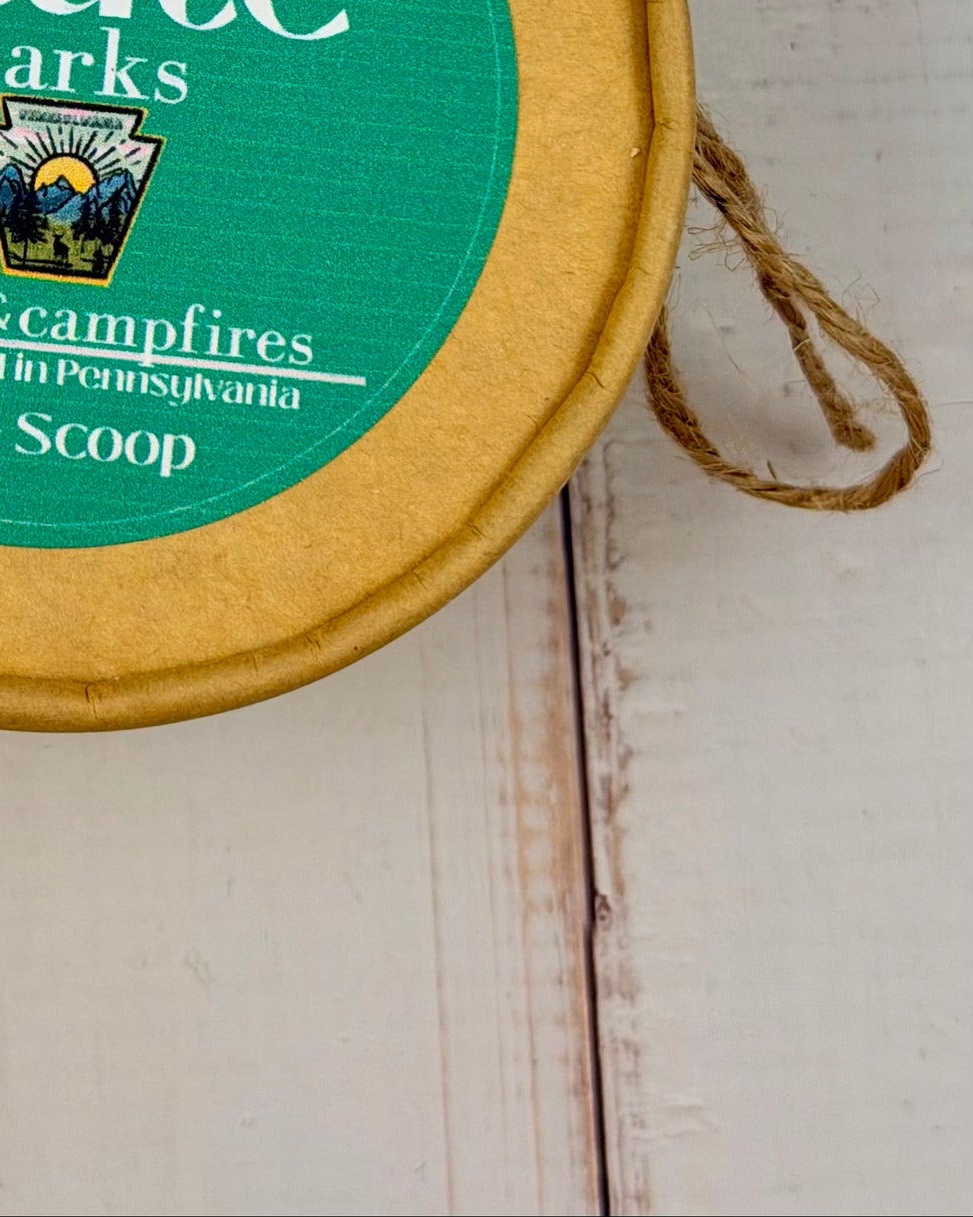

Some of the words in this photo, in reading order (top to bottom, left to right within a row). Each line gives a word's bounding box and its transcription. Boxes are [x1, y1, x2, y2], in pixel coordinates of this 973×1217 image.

[13, 352, 47, 384] in
[57, 359, 300, 410] Pennsylvania
[15, 412, 196, 477] Scoop
